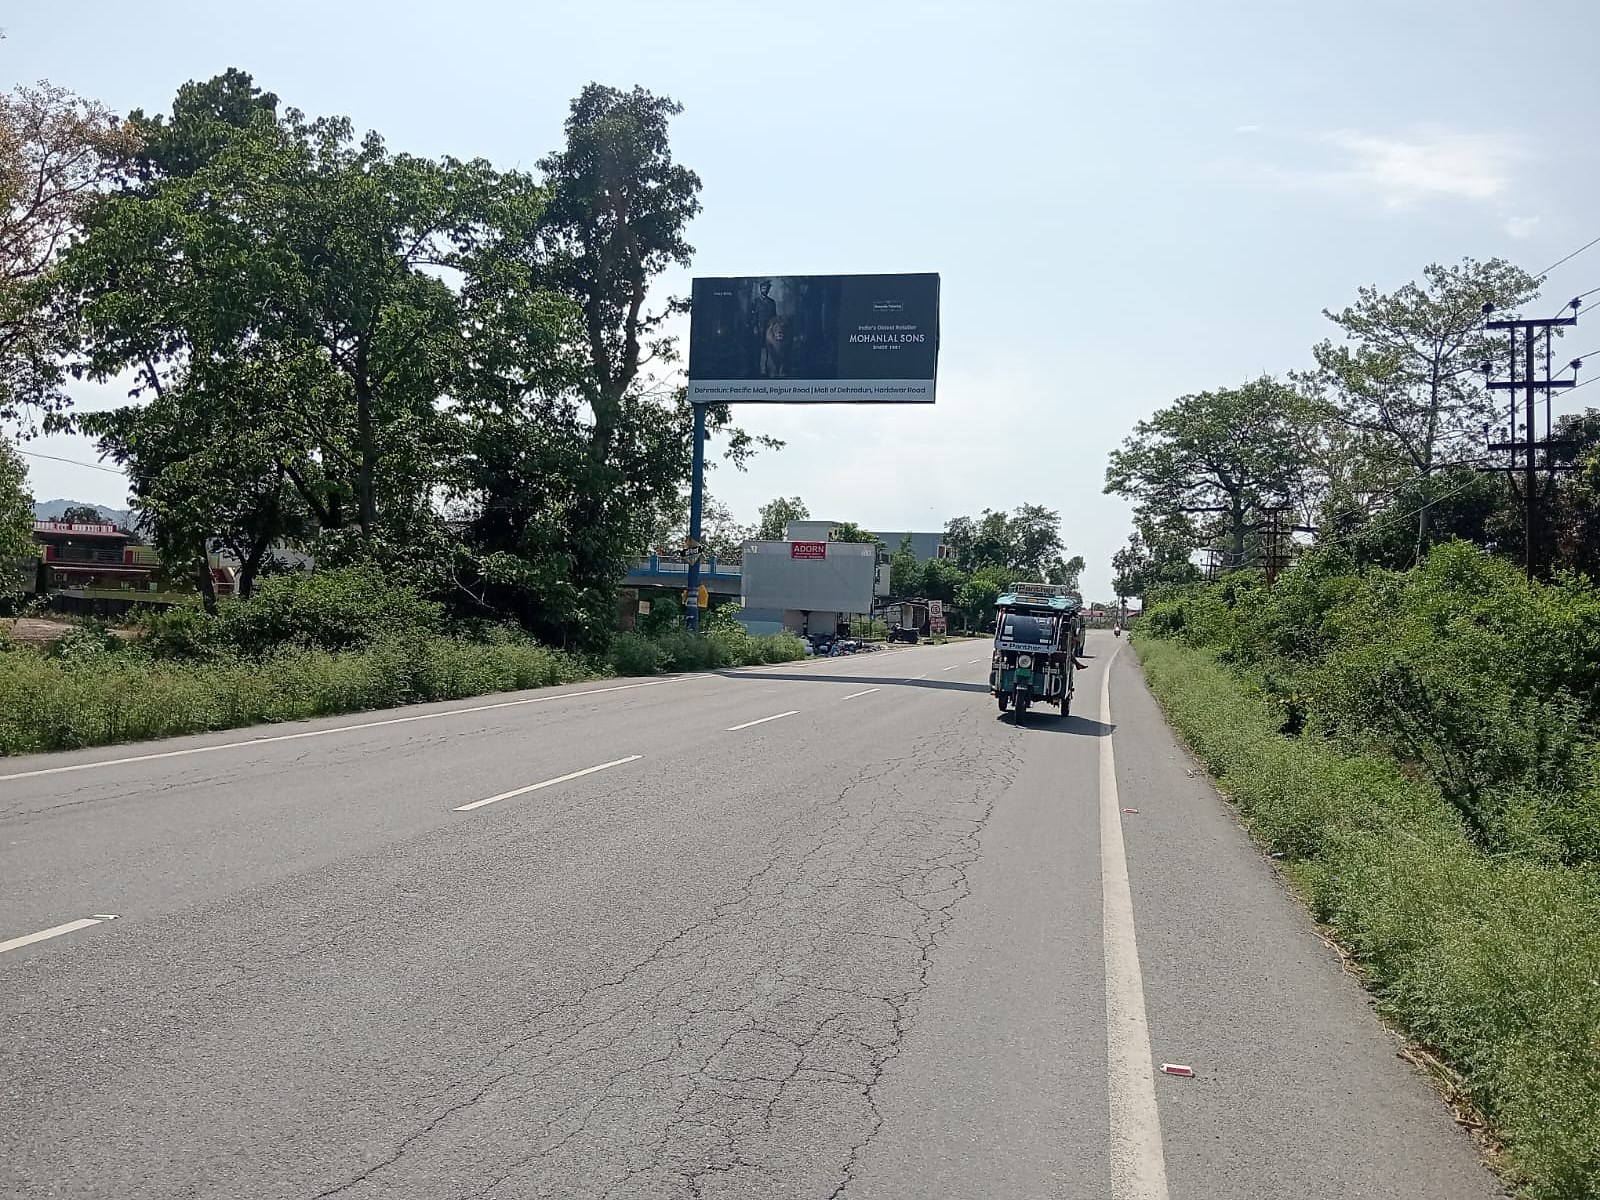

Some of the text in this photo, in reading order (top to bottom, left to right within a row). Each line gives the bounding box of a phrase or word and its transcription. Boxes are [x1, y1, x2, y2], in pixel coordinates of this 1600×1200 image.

[849, 334, 925, 343] MOHANLAL SONS
[769, 386, 791, 396] Rajpur
[874, 386, 907, 394] Haridwar
[793, 545, 824, 553] ADORN
[1018, 584, 1056, 595] Panther
[1009, 642, 1042, 651] Panther
